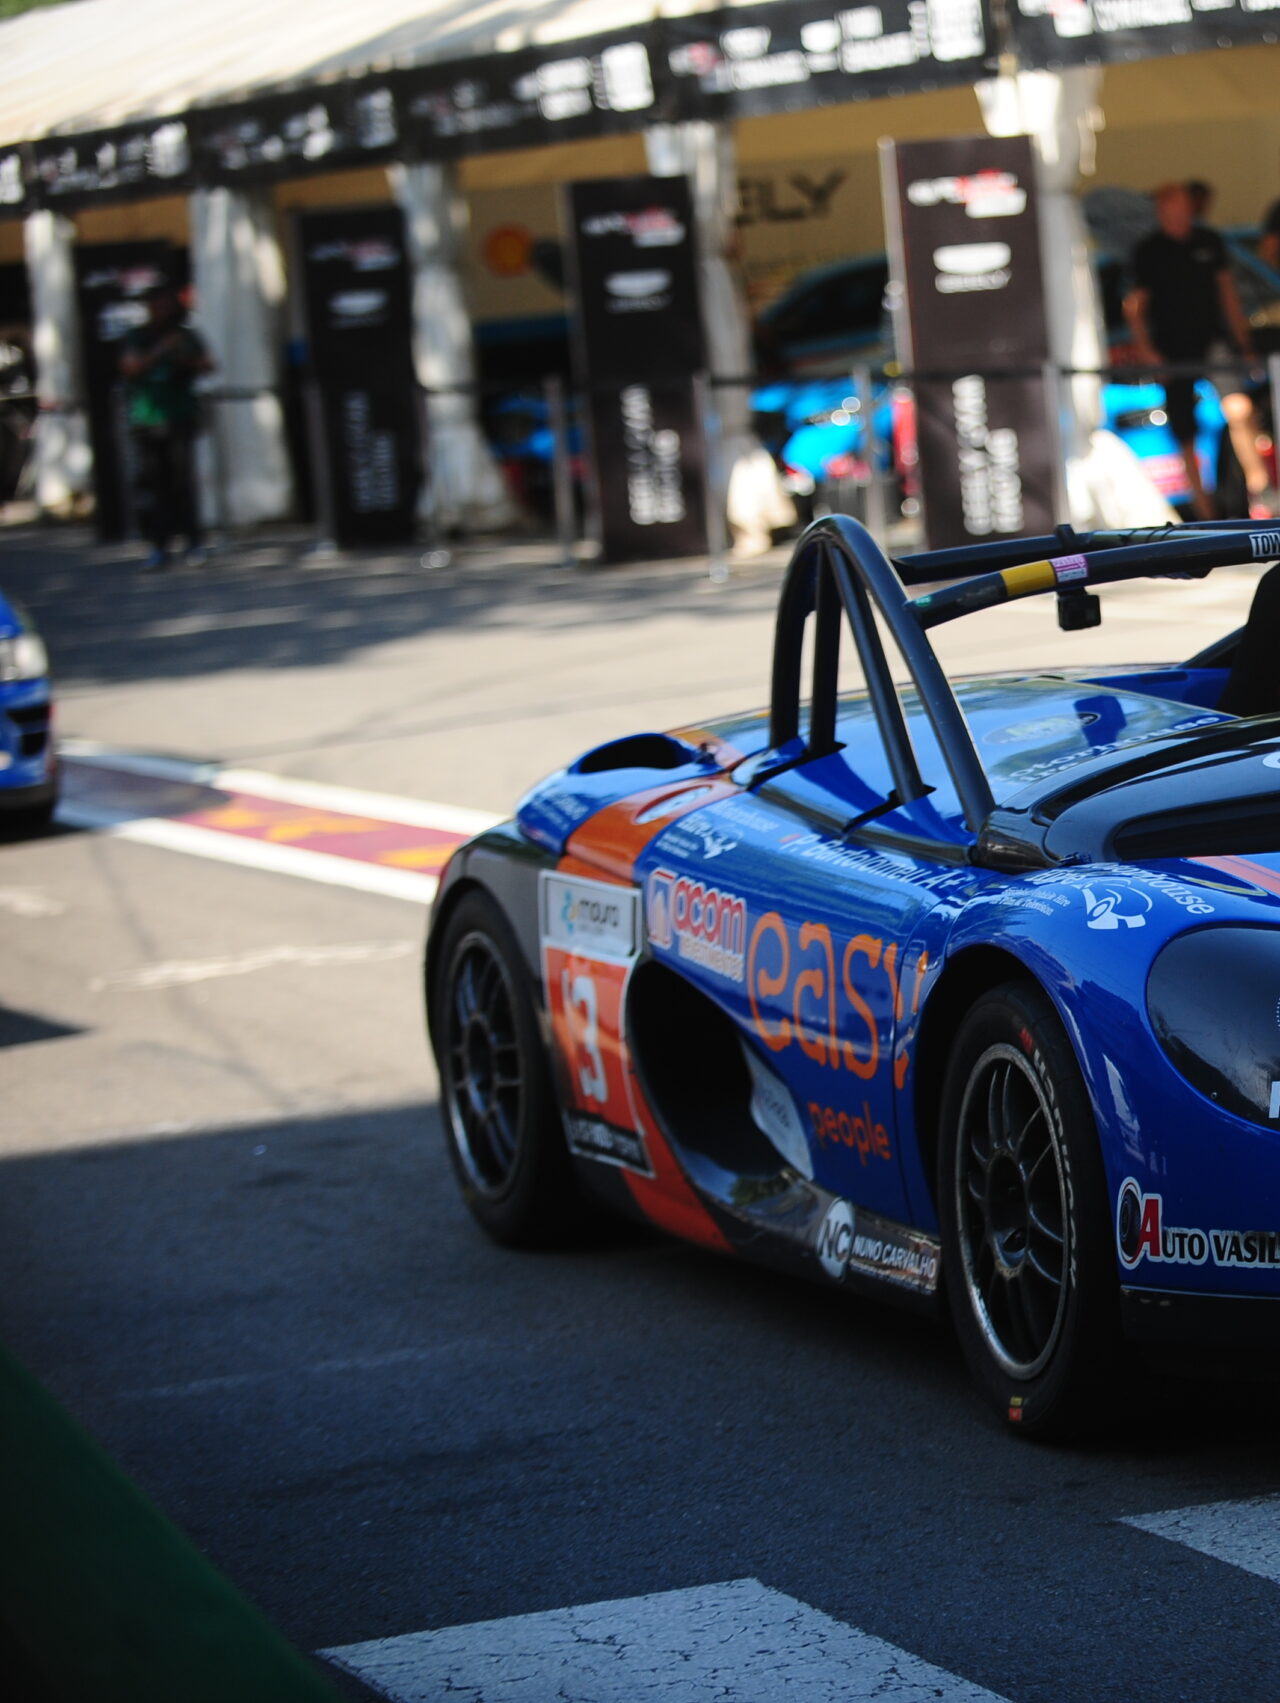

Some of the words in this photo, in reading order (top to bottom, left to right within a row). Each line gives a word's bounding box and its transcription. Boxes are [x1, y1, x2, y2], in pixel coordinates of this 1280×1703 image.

[807, 1101, 892, 1168] people
[851, 1234, 883, 1261] NUNO
[881, 1243, 938, 1279] CARVALHO
